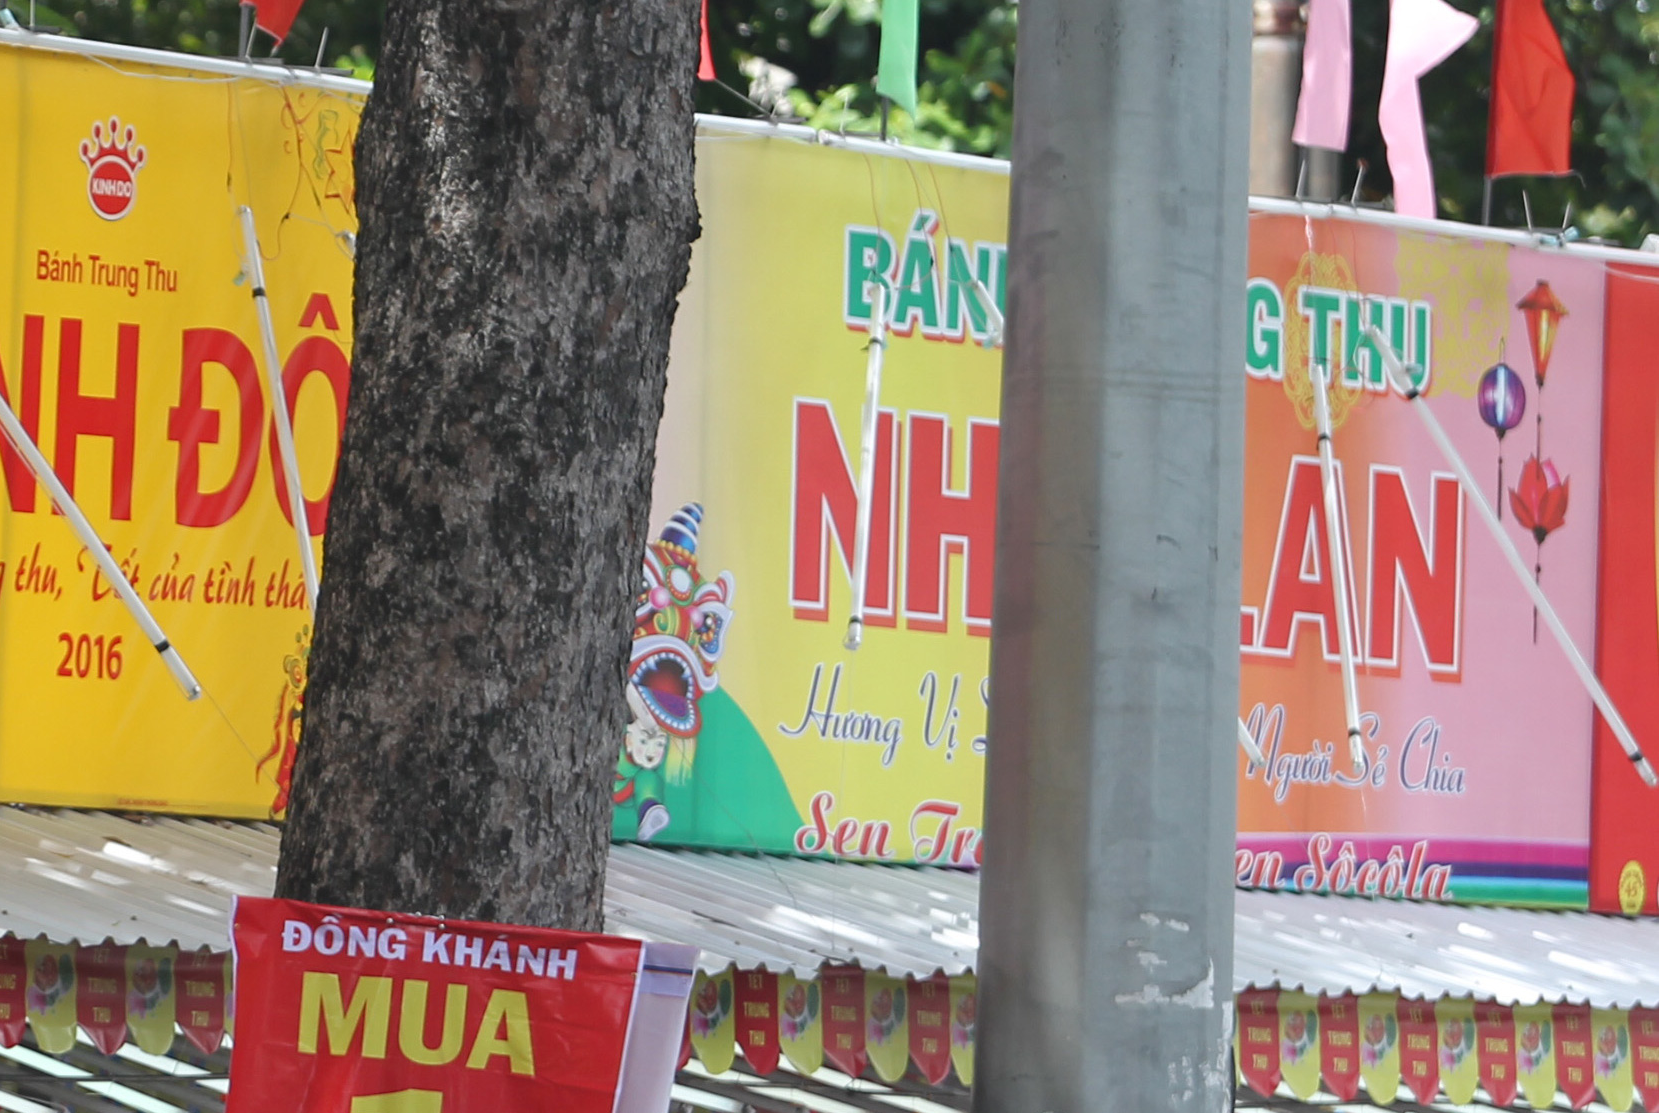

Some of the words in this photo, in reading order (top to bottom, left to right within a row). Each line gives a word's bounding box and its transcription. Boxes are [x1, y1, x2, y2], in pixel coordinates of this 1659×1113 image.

[37, 249, 83, 284] Bánh
[89, 254, 140, 297] Trung
[144, 259, 178, 292] Thu
[844, 207, 1006, 341] BÁN
[1298, 285, 1432, 398] THU
[167, 292, 353, 537] ĐÔ
[789, 396, 1001, 627] NH
[14, 542, 63, 601] thu,
[149, 551, 195, 602] của
[202, 556, 256, 606] tình
[265, 557, 311, 610] thâ
[57, 632, 123, 680] 2016
[778, 662, 902, 766] Hương
[919, 671, 961, 761] Vị
[1245, 702, 1333, 803] Người
[1399, 716, 1466, 794] Chia
[795, 791, 894, 859] Sen
[1294, 832, 1453, 899] Sôcôla
[422, 930, 578, 981] KHÁNH
[297, 971, 536, 1077] MUA
